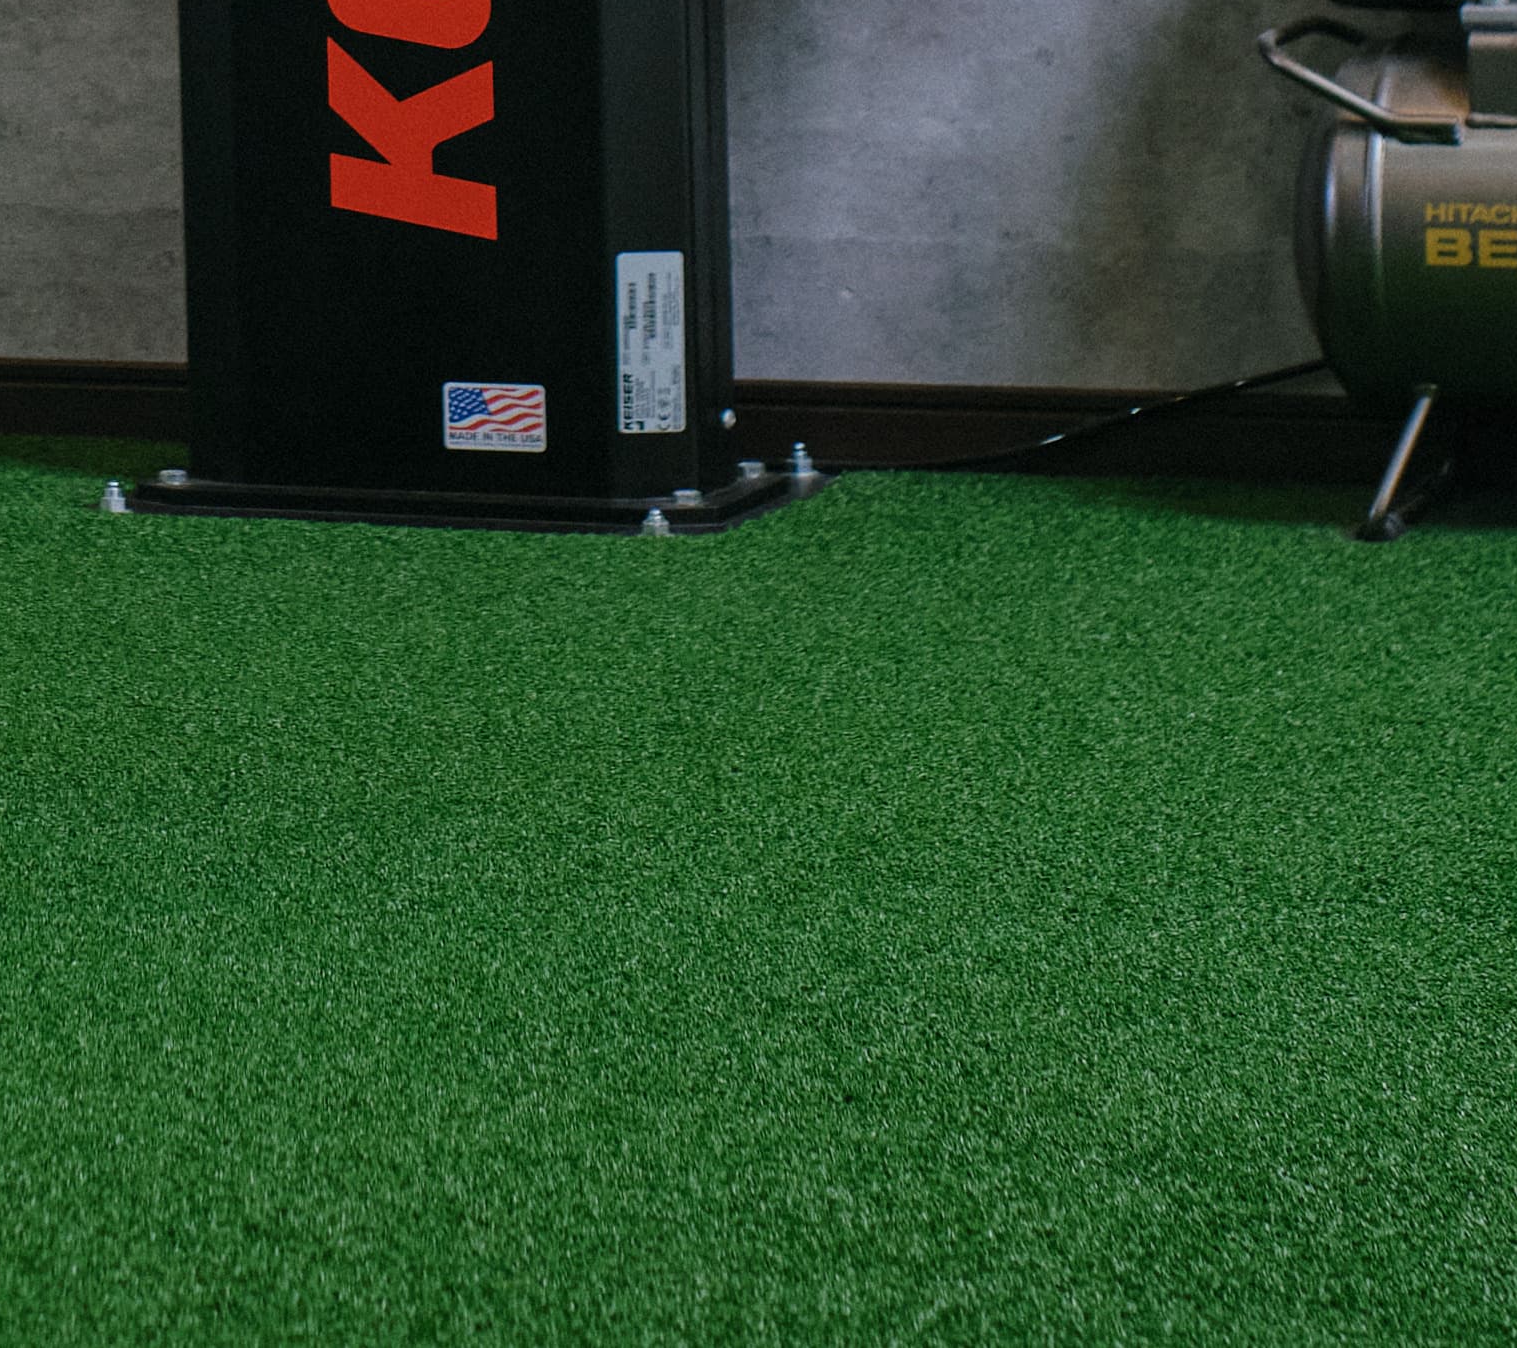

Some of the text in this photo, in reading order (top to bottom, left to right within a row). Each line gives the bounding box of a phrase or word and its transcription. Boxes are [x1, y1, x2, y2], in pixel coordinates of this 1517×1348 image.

[622, 373, 634, 431] KEISER
[448, 431, 542, 444] MADE IN THE USA
